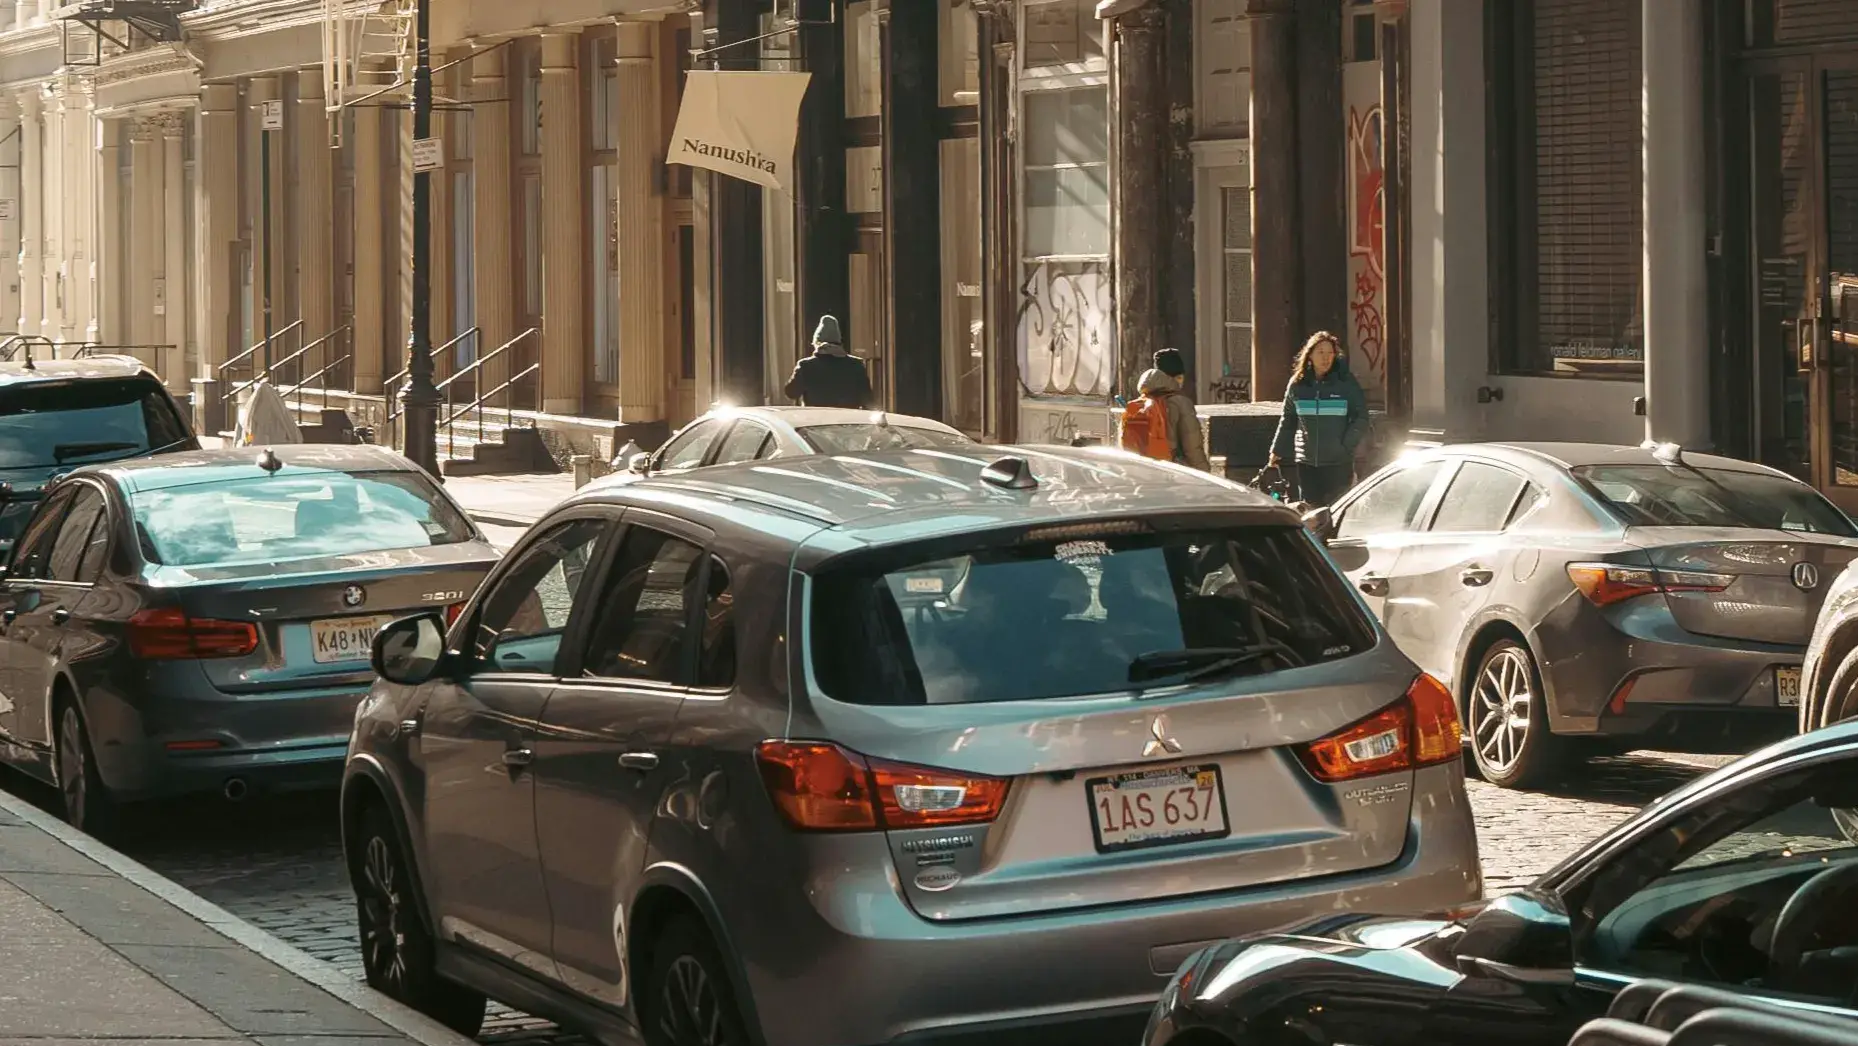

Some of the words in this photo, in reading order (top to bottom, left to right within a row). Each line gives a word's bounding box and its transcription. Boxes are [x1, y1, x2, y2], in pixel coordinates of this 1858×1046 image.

[682, 138, 776, 175] Nanushka
[317, 629, 348, 652] K48
[1100, 792, 1154, 833] 1AS
[1164, 786, 1214, 824] 637
[902, 835, 974, 854] MITSUBISHI
